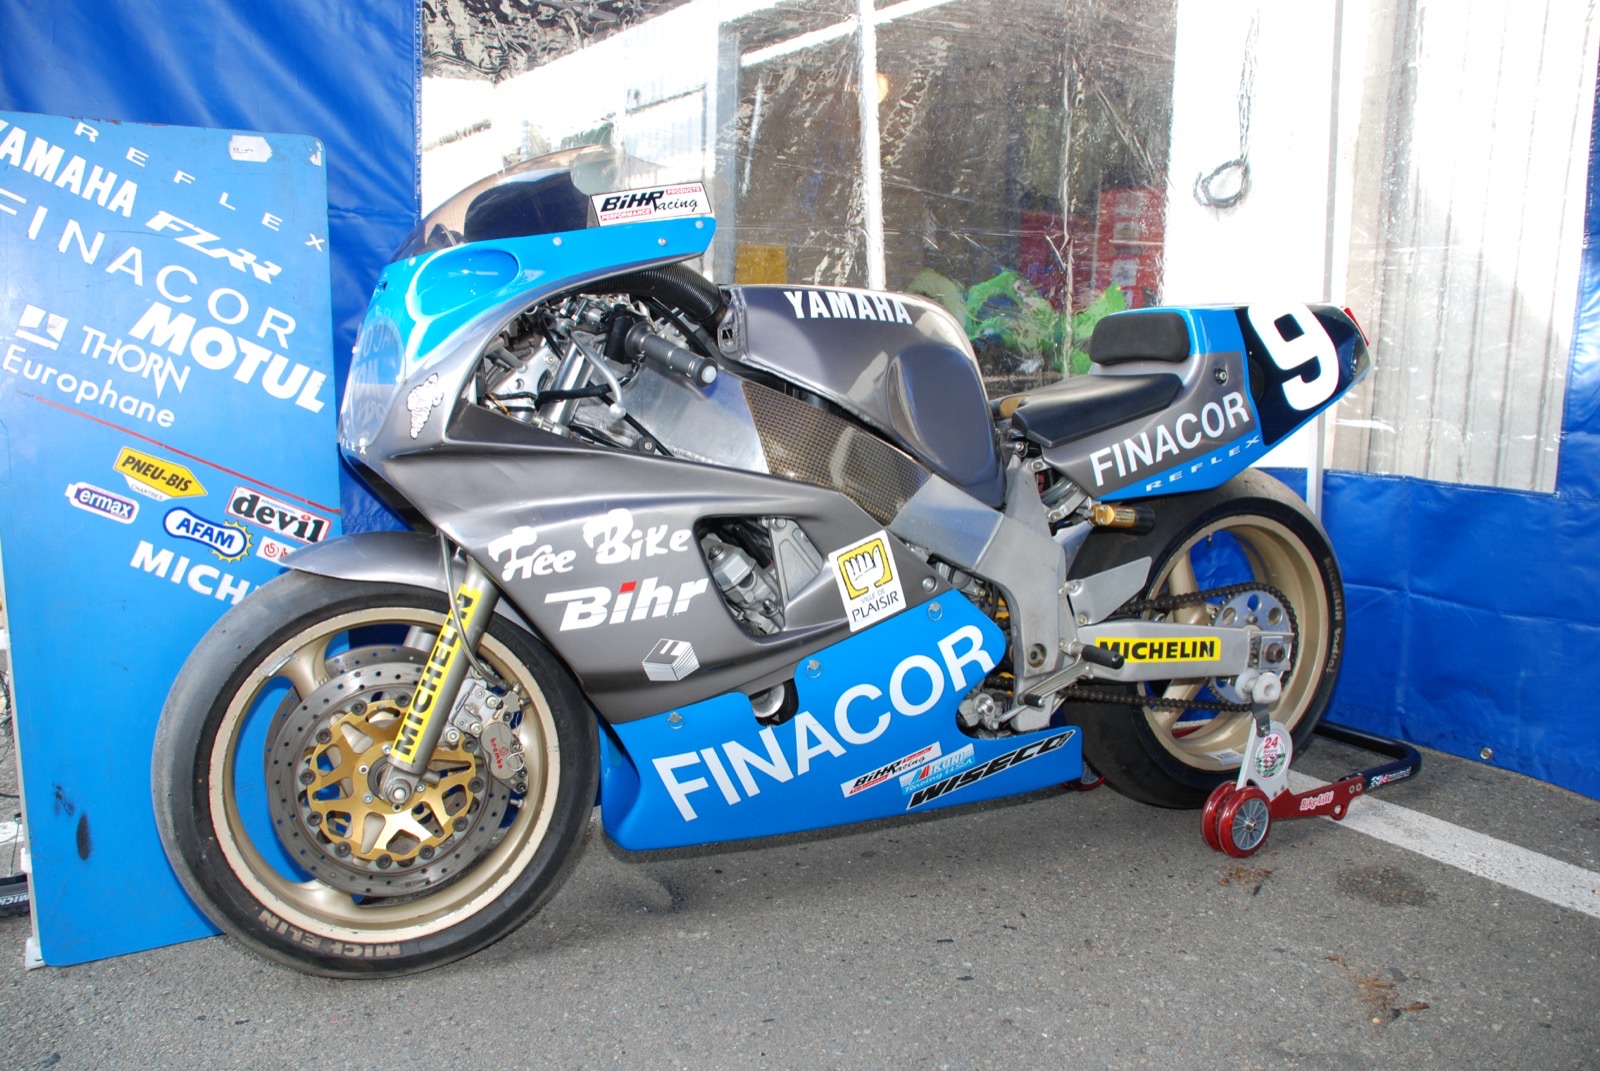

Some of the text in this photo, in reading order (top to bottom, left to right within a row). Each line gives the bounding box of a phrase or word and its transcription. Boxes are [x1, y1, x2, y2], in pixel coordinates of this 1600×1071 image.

[74, 121, 326, 252] REFLEX
[666, 186, 702, 196] PRODUCTS
[600, 208, 651, 221] PERFORMANCE
[783, 290, 913, 325] YAMAHA
[81, 325, 191, 399] THORN
[128, 301, 327, 413] MOTUL
[1248, 301, 1340, 412] 9
[2, 343, 175, 428] Europhane
[1089, 391, 1250, 488] FINACOR
[1145, 434, 1261, 493] REFLEX
[121, 455, 192, 492] PNEU-BIS
[79, 489, 133, 519] ermax
[232, 493, 325, 544] devil
[175, 517, 236, 549] AFAM
[488, 525, 577, 582] Free
[129, 539, 260, 606] MICH
[860, 587, 886, 604] VILLE DE
[544, 576, 709, 632] Bihr
[851, 590, 899, 622] PLAISIR
[1098, 640, 1216, 660] MICHELIN
[651, 624, 997, 823] FINACOR
[1263, 736, 1279, 750] 24
[489, 736, 503, 770] brembo
[907, 729, 1076, 810] WISECO
[257, 909, 401, 958] MICHELIN
